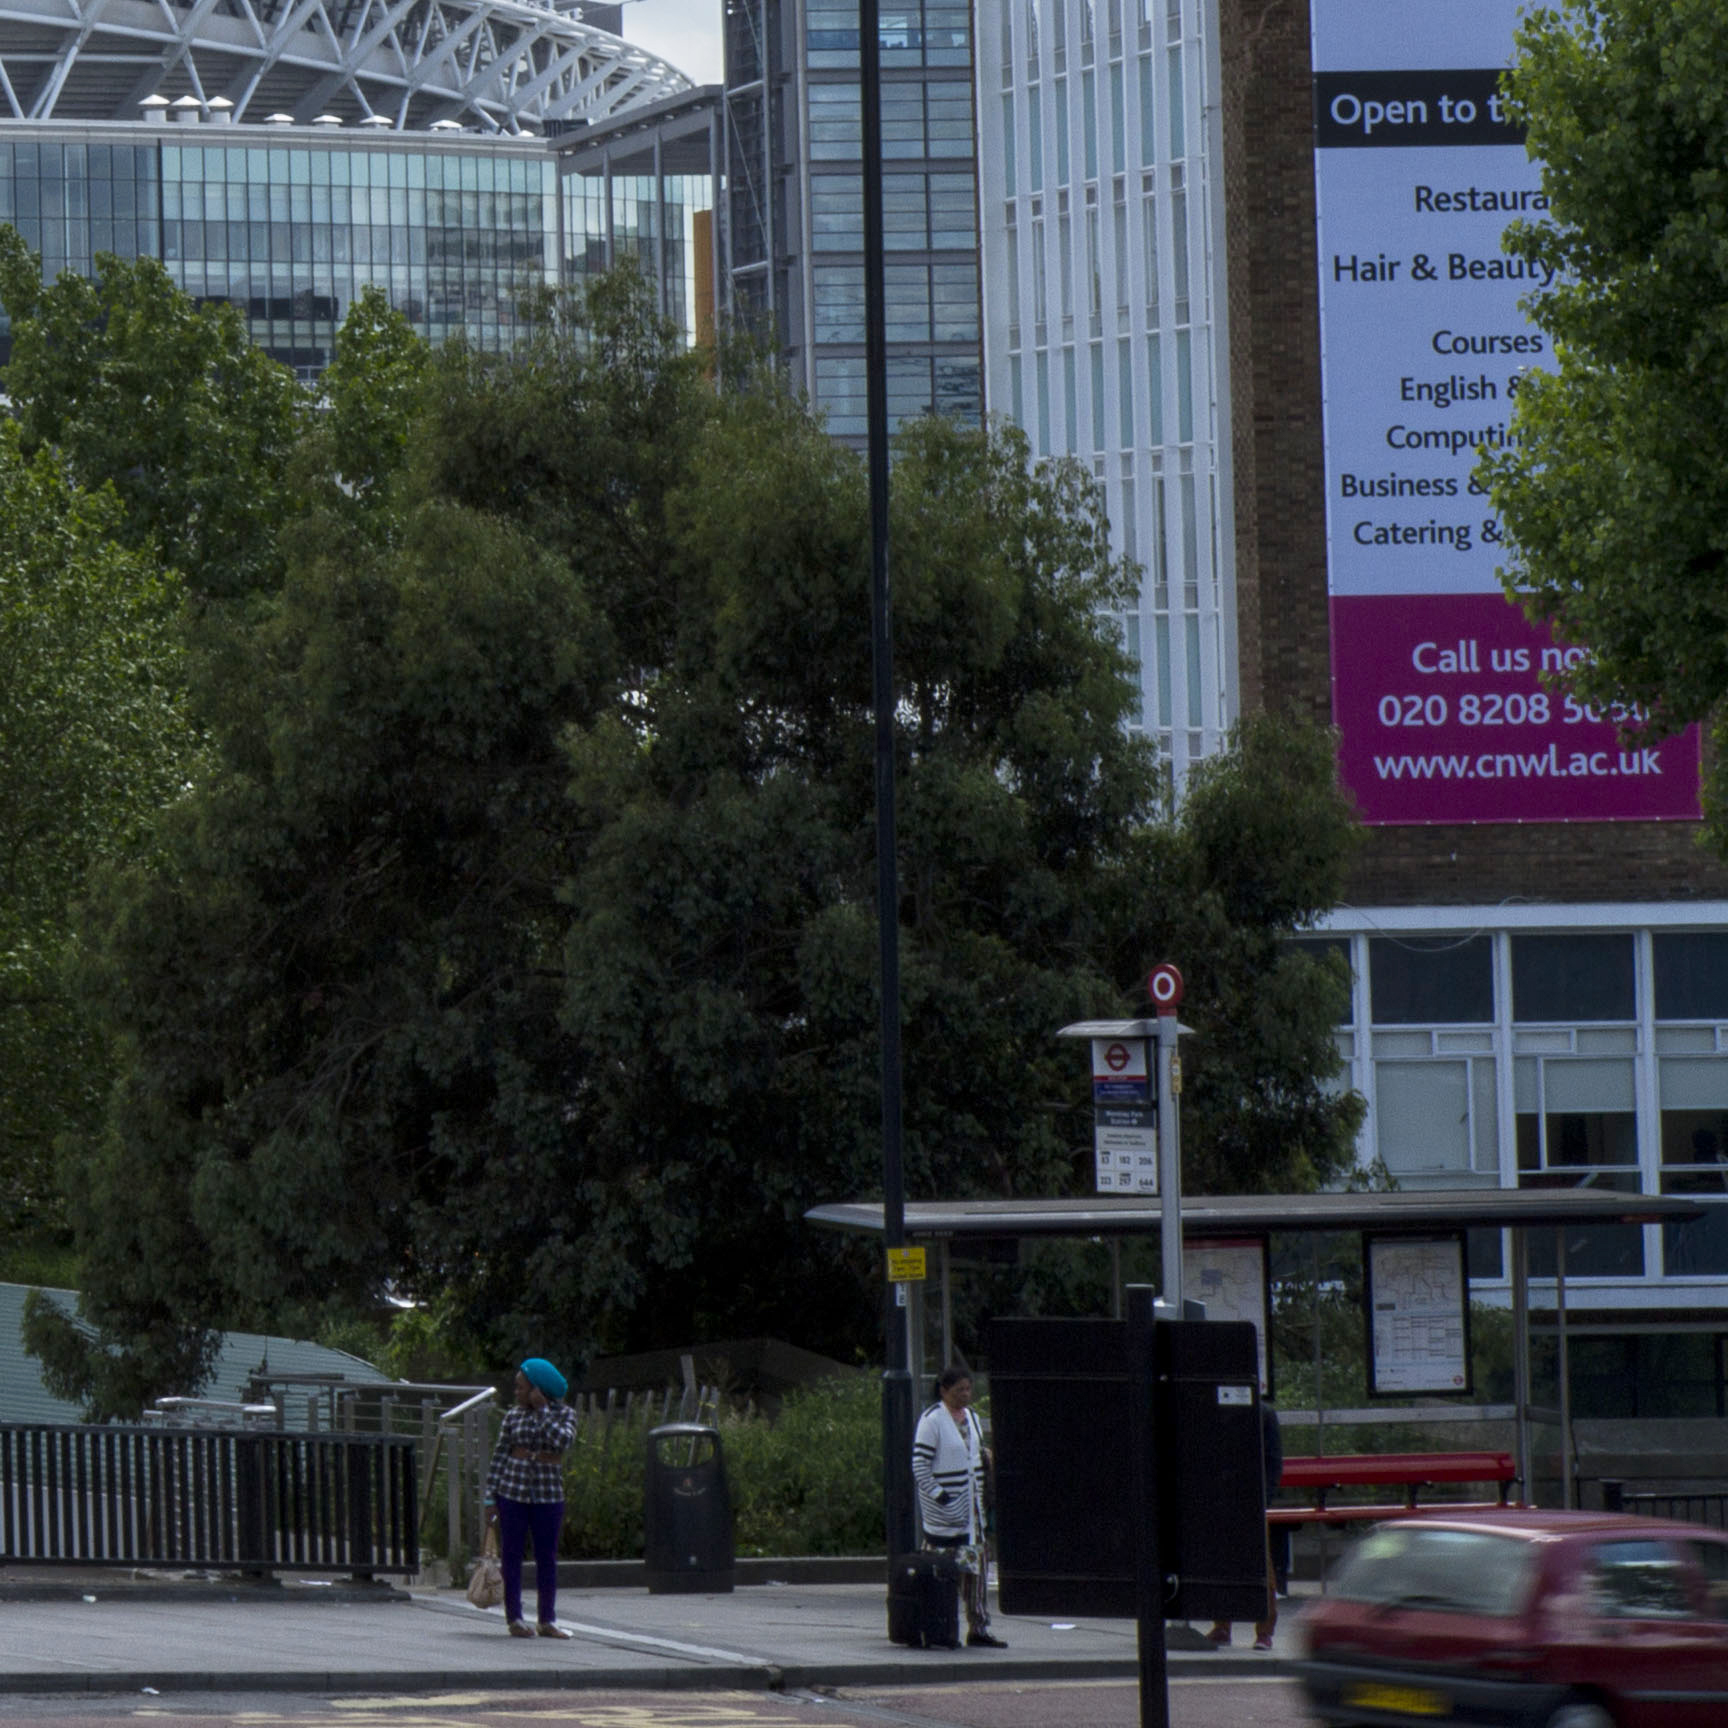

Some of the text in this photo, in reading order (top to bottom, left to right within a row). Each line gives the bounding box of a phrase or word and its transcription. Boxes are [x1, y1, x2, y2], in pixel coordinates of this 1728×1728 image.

[1330, 93, 1428, 134] Open
[1439, 96, 1478, 124] to
[1415, 185, 1550, 213] Restaura
[1333, 252, 1556, 287] Hair & Beauty
[1431, 330, 1544, 356] Courses
[1400, 376, 1498, 409] English
[1385, 423, 1524, 456] Computin
[1341, 473, 1492, 499] Business &
[1353, 519, 1503, 551] Catering &
[1411, 639, 1480, 674] Call
[1491, 647, 1531, 673] us
[1377, 695, 1447, 727] 020
[1458, 693, 1550, 725] 8208
[1373, 743, 1663, 780] www.cnwl.ac.uk
